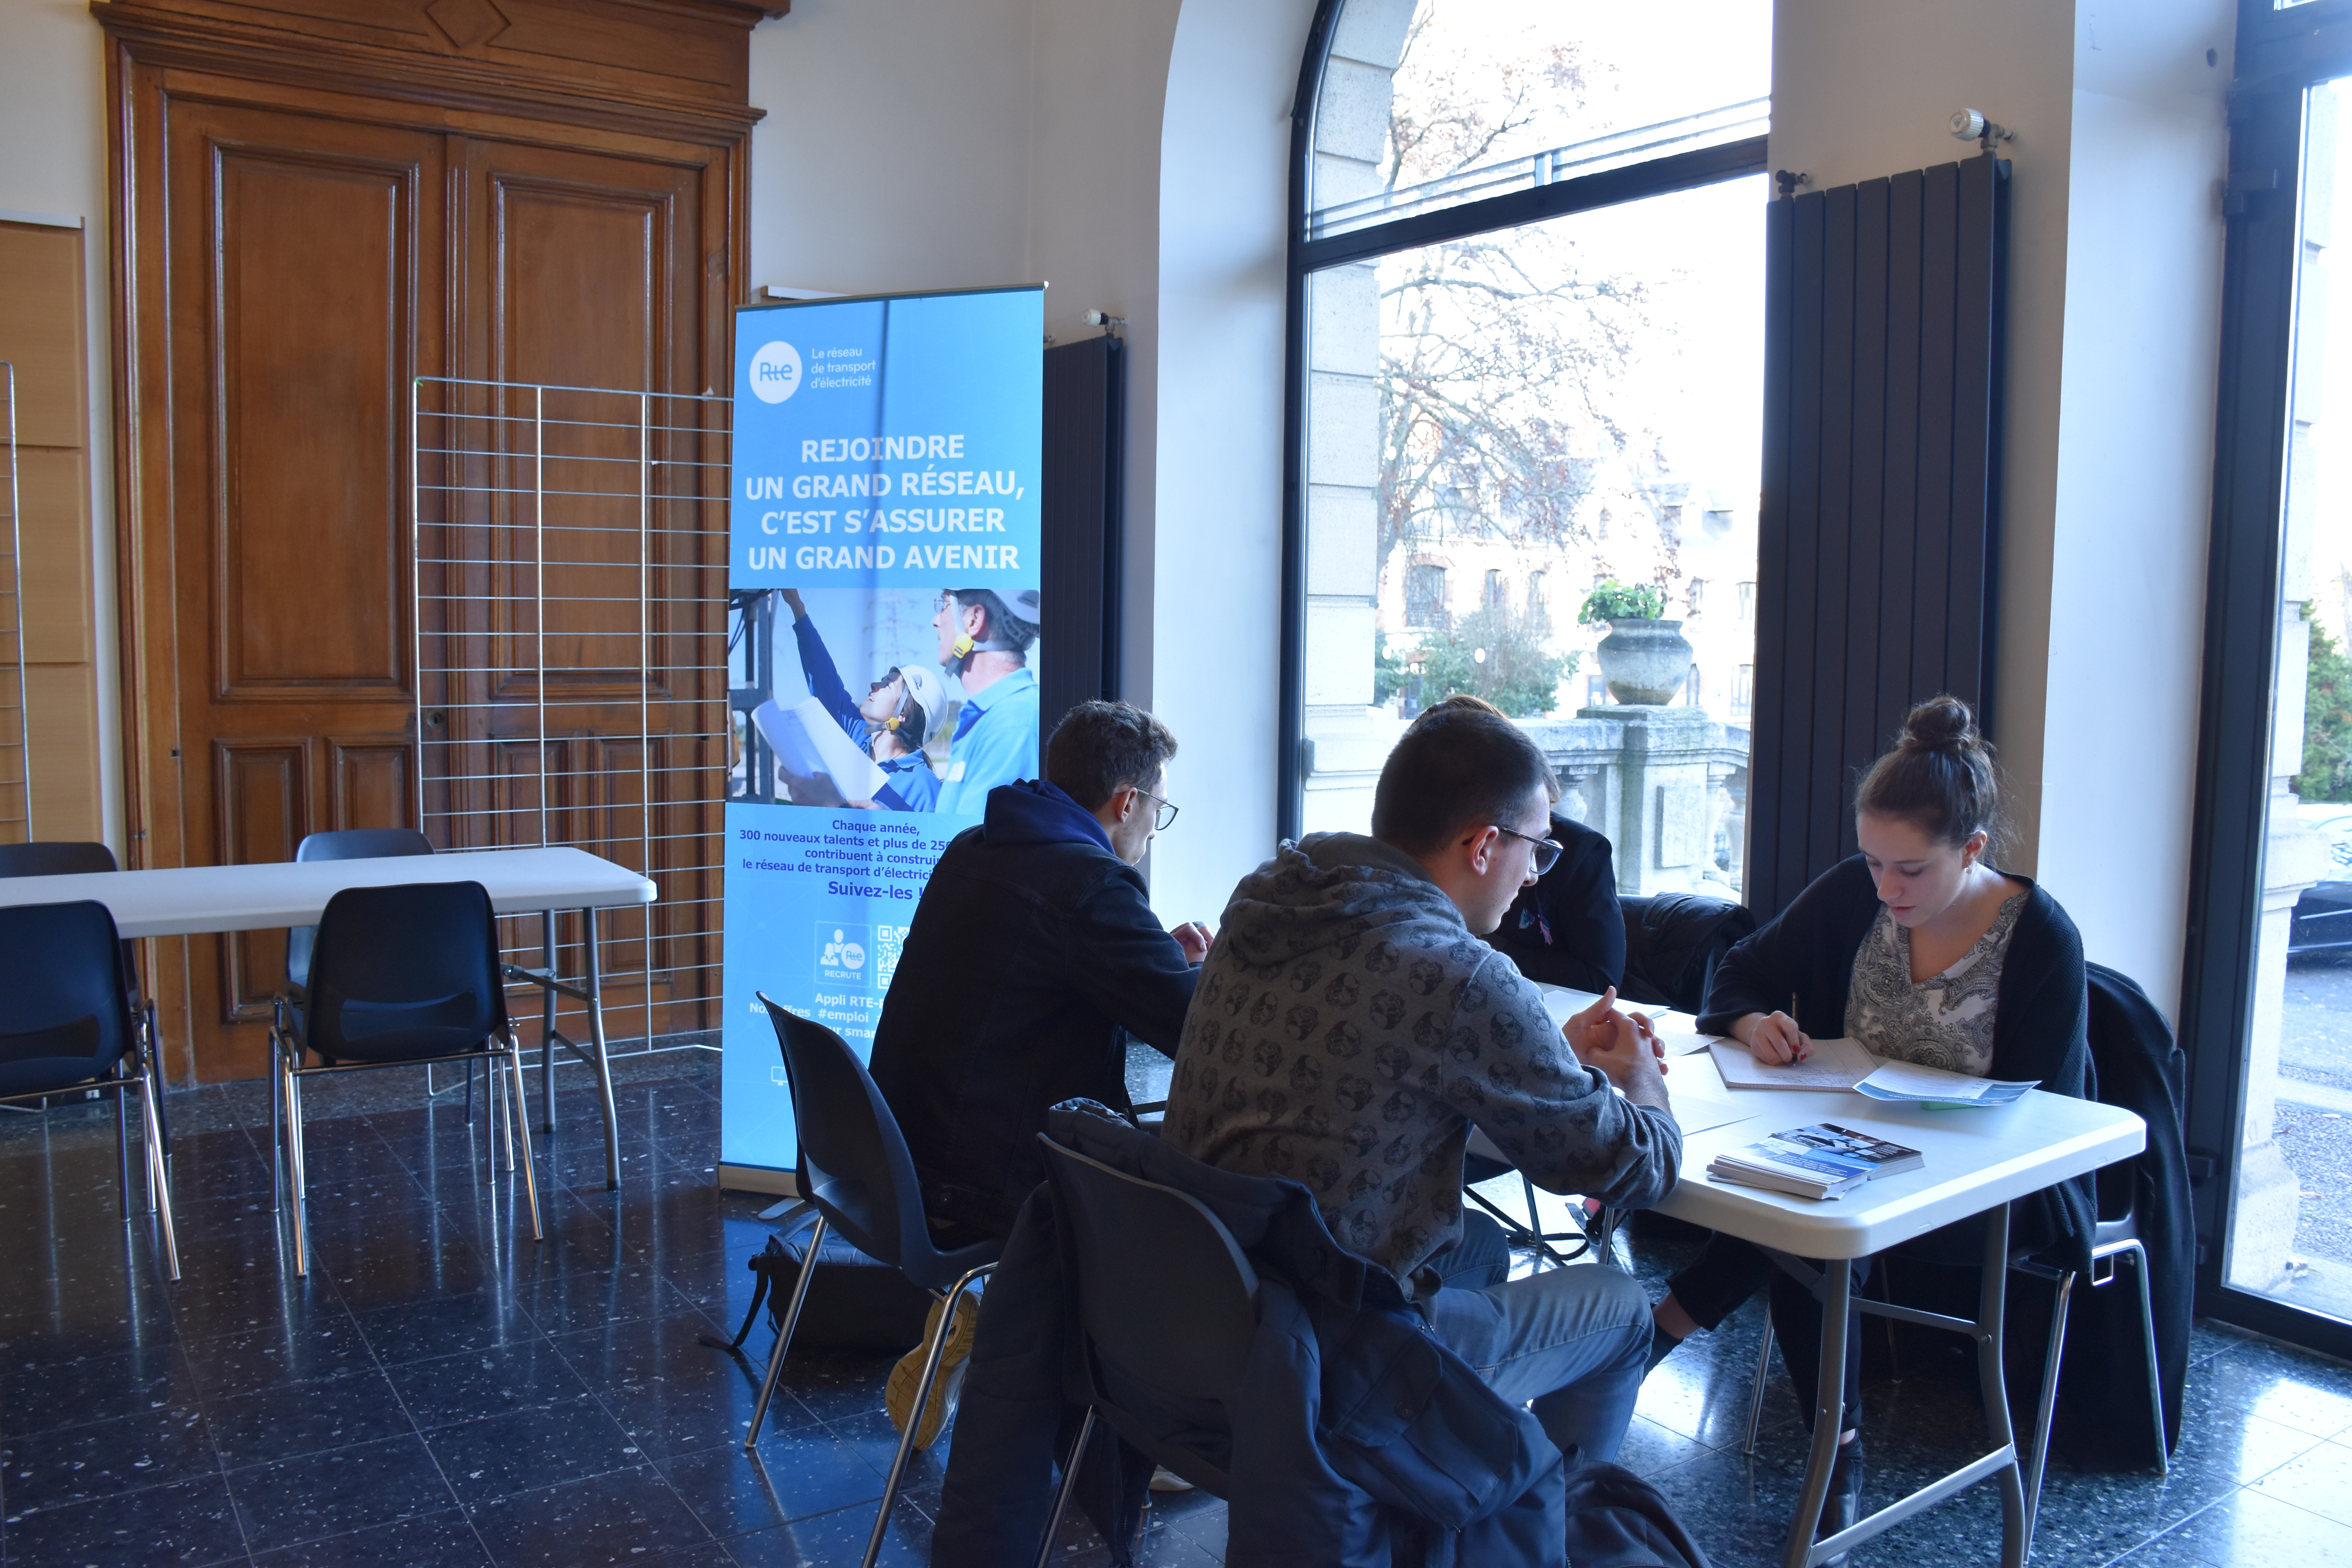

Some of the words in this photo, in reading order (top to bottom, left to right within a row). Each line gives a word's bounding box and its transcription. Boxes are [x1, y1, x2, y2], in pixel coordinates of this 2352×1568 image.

[811, 348, 824, 359] Le
[827, 347, 862, 358] réseau
[760, 362, 793, 382] Rte
[811, 363, 824, 374] de
[827, 360, 876, 374] transport
[802, 435, 964, 463] REJOINDRE
[746, 477, 783, 500] UN
[792, 474, 891, 499] GRAND
[902, 464, 1024, 500] RÉSEAU,
[749, 547, 785, 570] UN
[796, 546, 895, 570] GRAND
[904, 545, 1020, 569] AVENIR
[832, 820, 877, 833] Chaque
[880, 823, 920, 836] année,
[740, 829, 760, 840] 300
[764, 833, 820, 843] nouveaux
[824, 834, 864, 846] talents
[867, 837, 880, 847] et
[883, 838, 908, 850] plus
[911, 839, 926, 850] de
[805, 849, 873, 862] contribuent
[876, 851, 883, 862] à
[743, 858, 752, 869] le
[756, 859, 794, 871] réseau
[798, 862, 812, 872] de
[815, 863, 870, 877] transport
[828, 881, 913, 900] Suivez-les
[846, 950, 863, 961] Rte
[825, 969, 861, 980] RECRUTE
[815, 993, 846, 1006] Appli
[818, 1008, 869, 1024] #emploi
